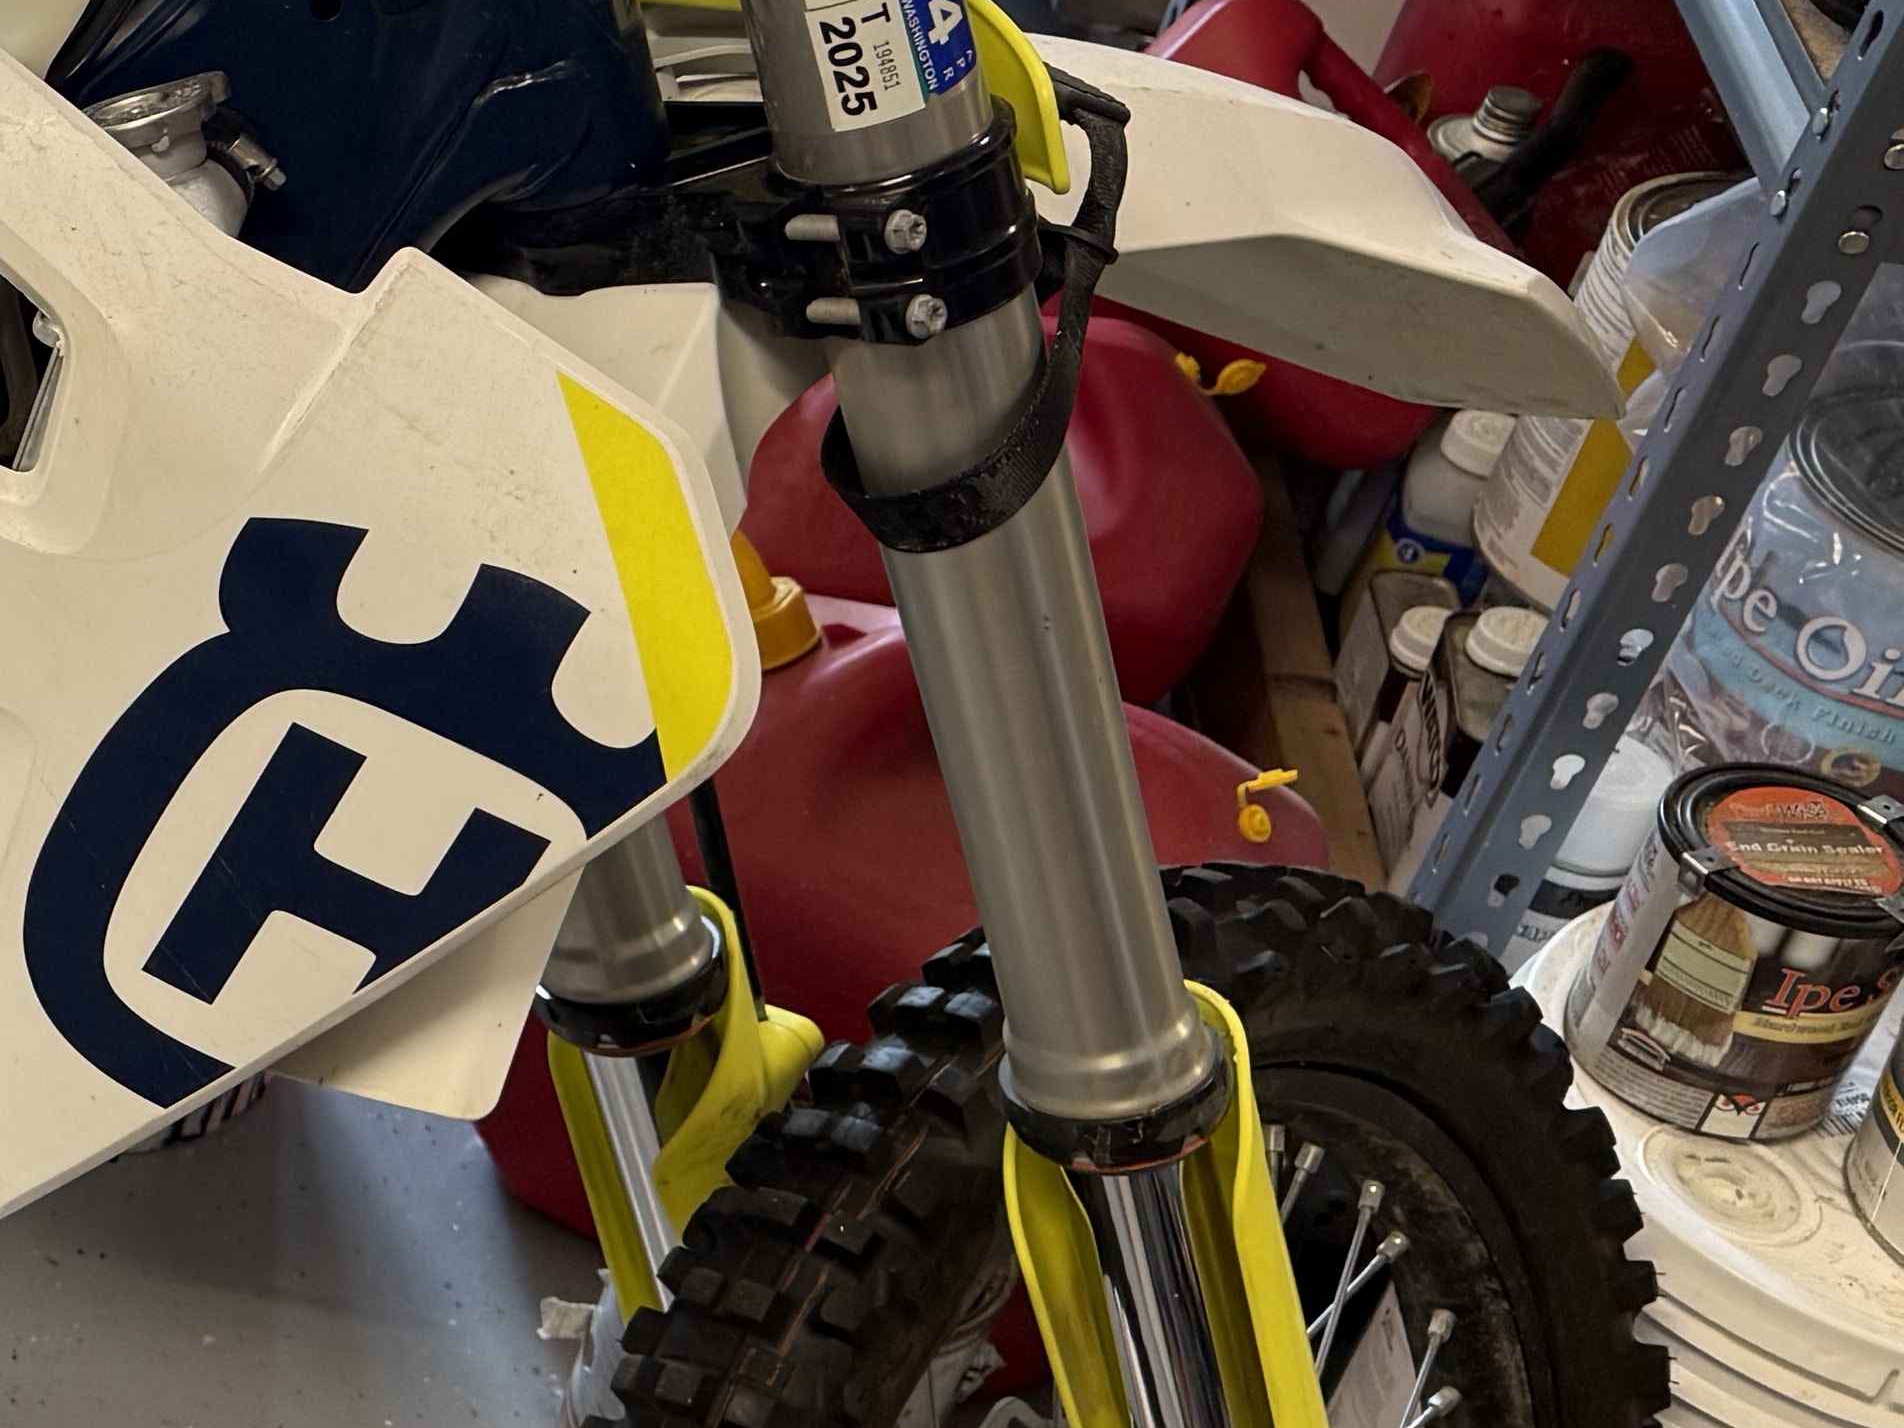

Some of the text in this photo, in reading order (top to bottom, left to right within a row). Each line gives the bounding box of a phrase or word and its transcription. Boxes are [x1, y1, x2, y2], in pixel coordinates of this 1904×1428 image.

[818, 17, 878, 118] 2025
[861, 3, 902, 91] T 194851
[1762, 966, 1854, 1020] Ipe
